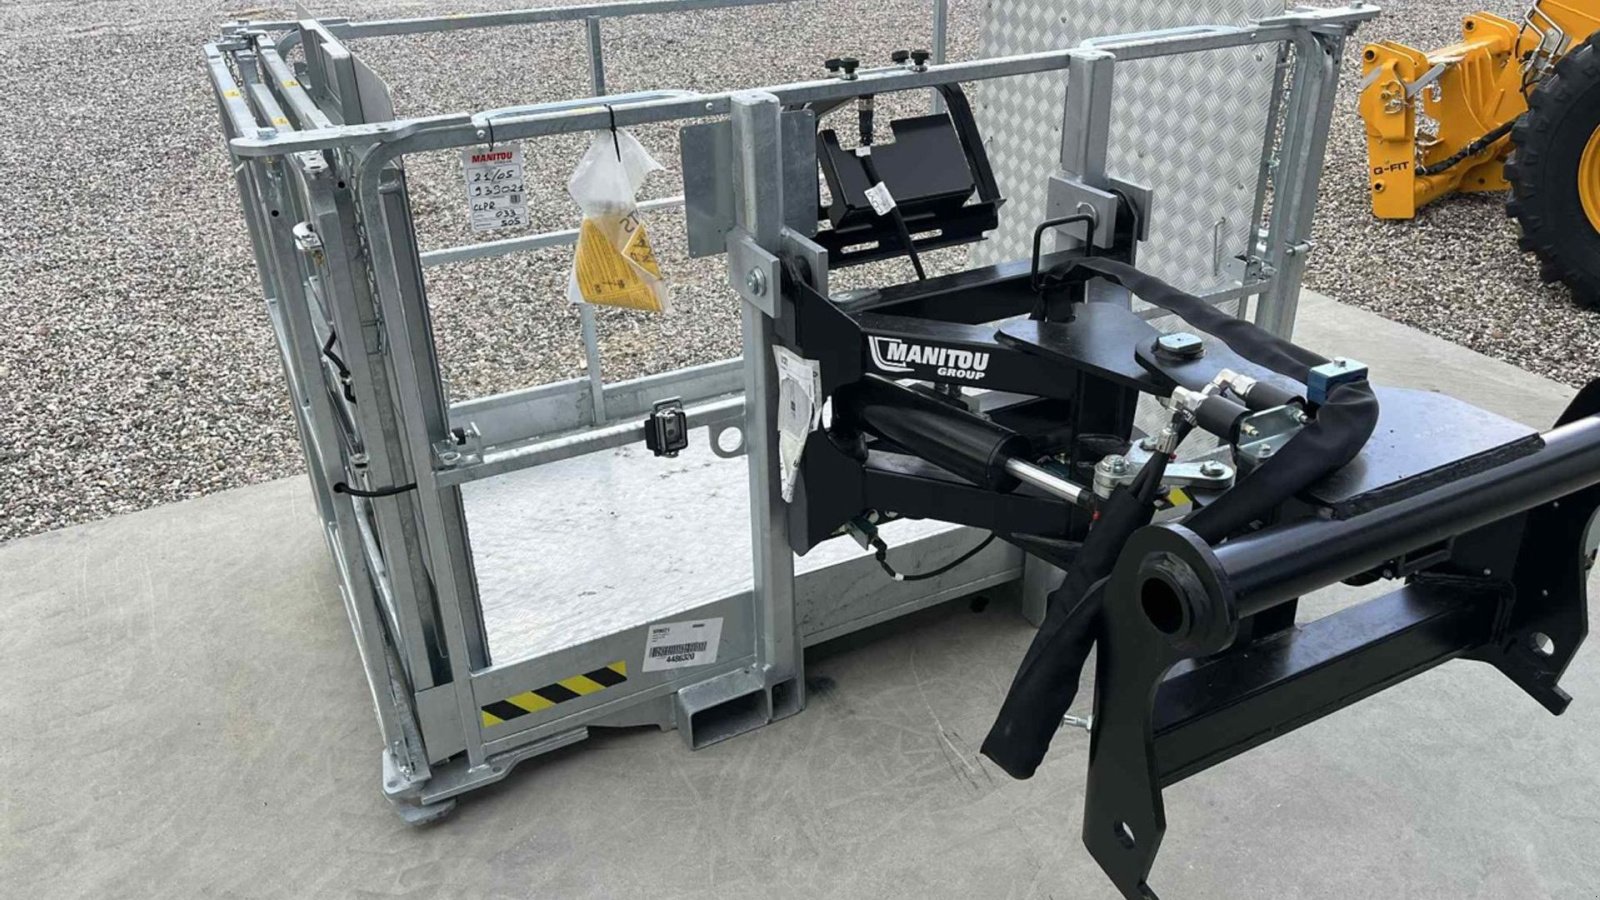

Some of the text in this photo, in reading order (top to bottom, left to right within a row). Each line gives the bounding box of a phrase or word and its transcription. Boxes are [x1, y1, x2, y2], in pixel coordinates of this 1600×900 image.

[471, 152, 513, 163] MANITOU
[474, 168, 514, 183] 21/05
[495, 209, 516, 218] 033
[887, 342, 989, 371] MANITOU
[937, 367, 985, 380] GROUP
